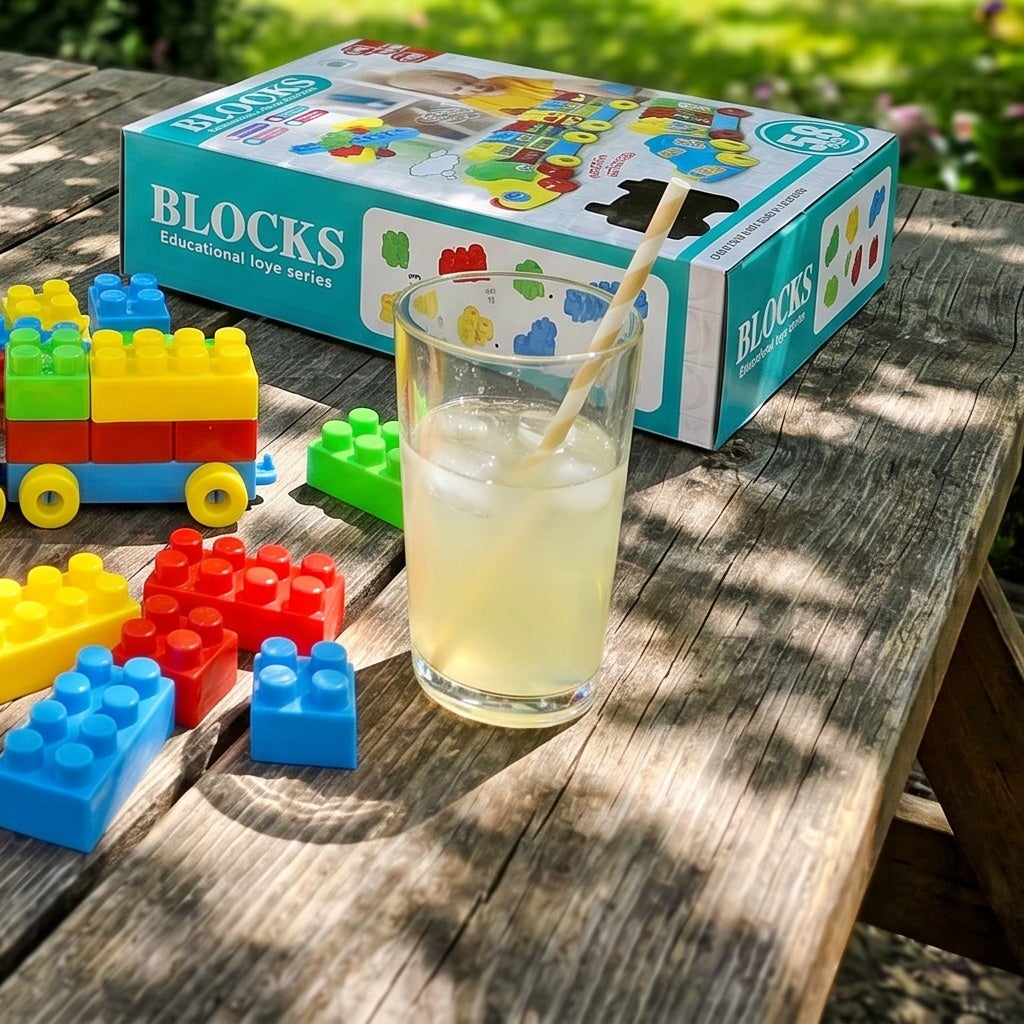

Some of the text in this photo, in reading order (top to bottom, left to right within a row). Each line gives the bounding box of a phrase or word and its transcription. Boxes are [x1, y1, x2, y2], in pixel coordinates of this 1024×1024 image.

[777, 125, 843, 151] 58
[150, 183, 345, 270] BLOCKS
[160, 230, 245, 265] Educational
[287, 266, 332, 289] series
[736, 263, 813, 365] BLOCKS
